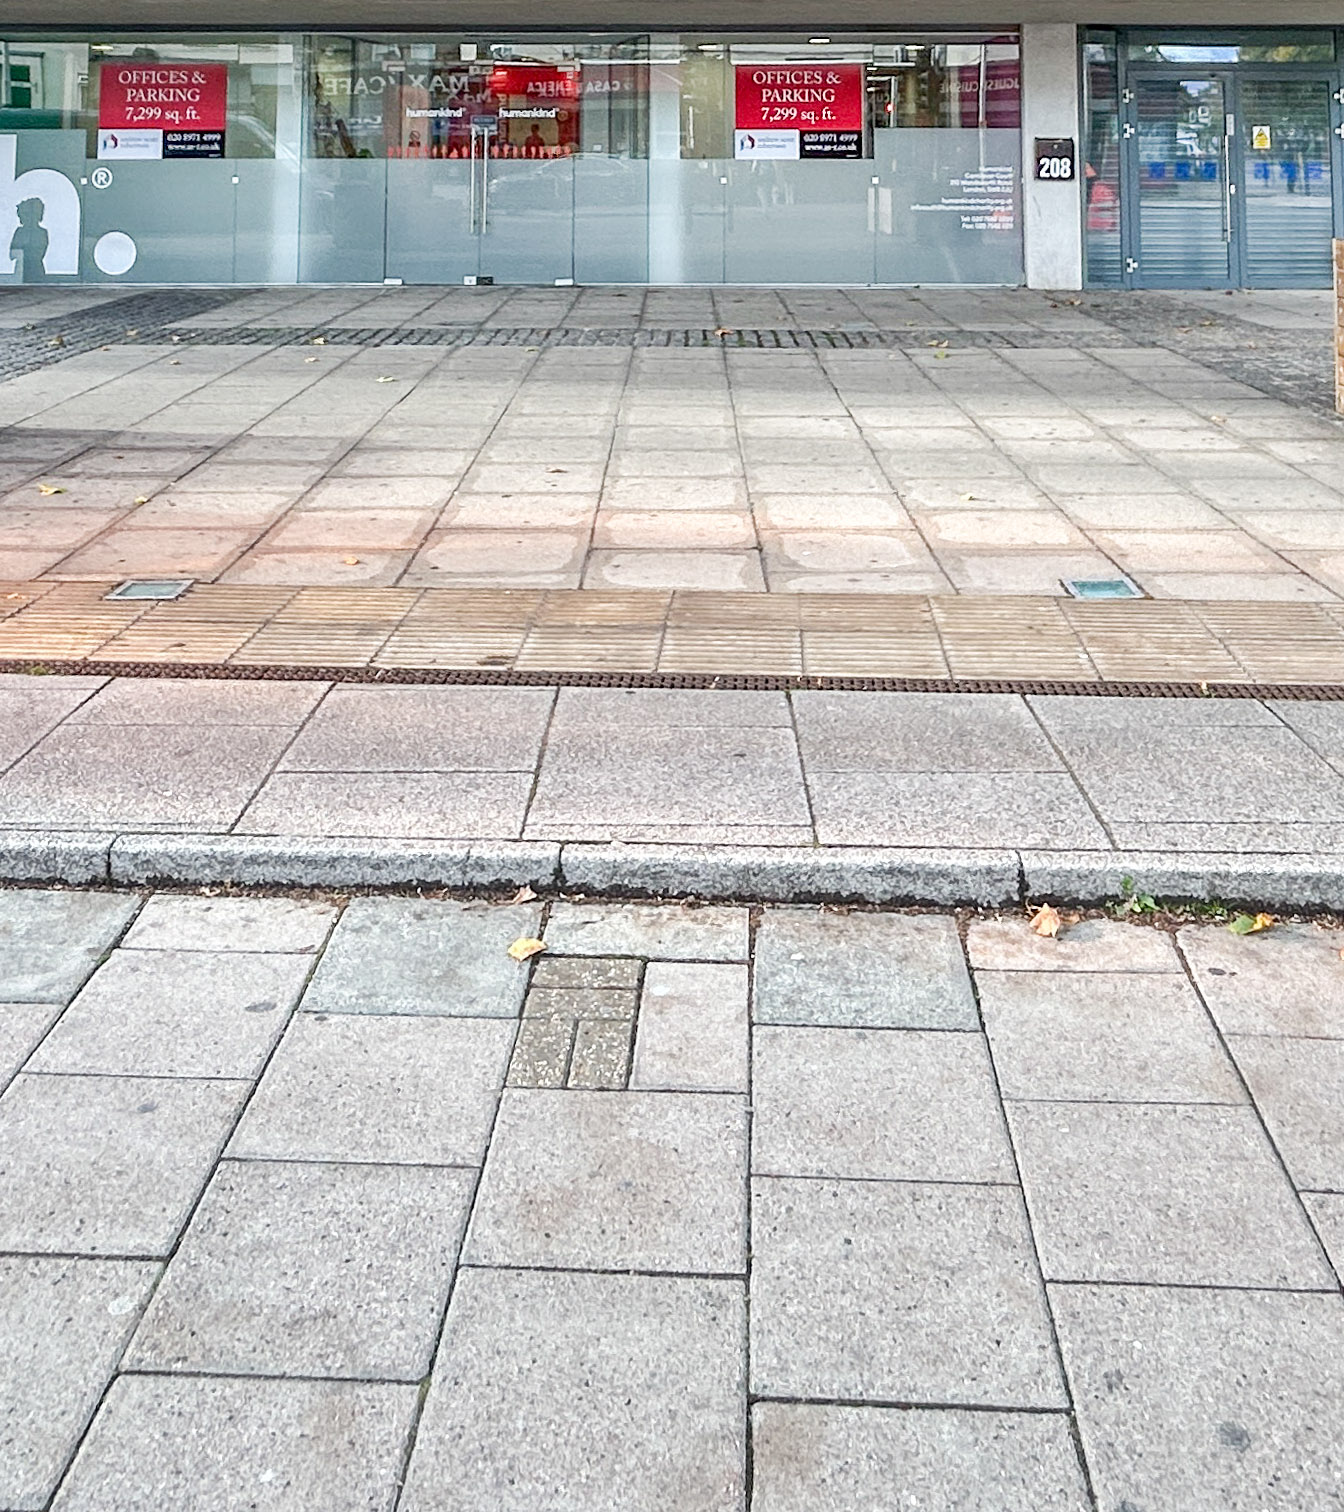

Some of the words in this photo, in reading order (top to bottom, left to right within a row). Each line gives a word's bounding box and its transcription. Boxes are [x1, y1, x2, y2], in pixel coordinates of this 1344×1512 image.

[118, 70, 188, 84] OFFICES
[191, 71, 207, 84] &
[753, 70, 823, 85] OFFICES
[826, 71, 842, 84] &
[125, 88, 200, 102] PARKING
[761, 88, 836, 103] PARKING
[125, 107, 162, 122] 7,299
[164, 110, 184, 125] sq.
[186, 106, 201, 120] ft.
[406, 107, 463, 118] humankind
[499, 107, 556, 118] humankind
[761, 107, 798, 123] 7,299
[800, 110, 819, 125] sq.
[822, 106, 836, 120] ft.
[1039, 157, 1072, 178] 208
